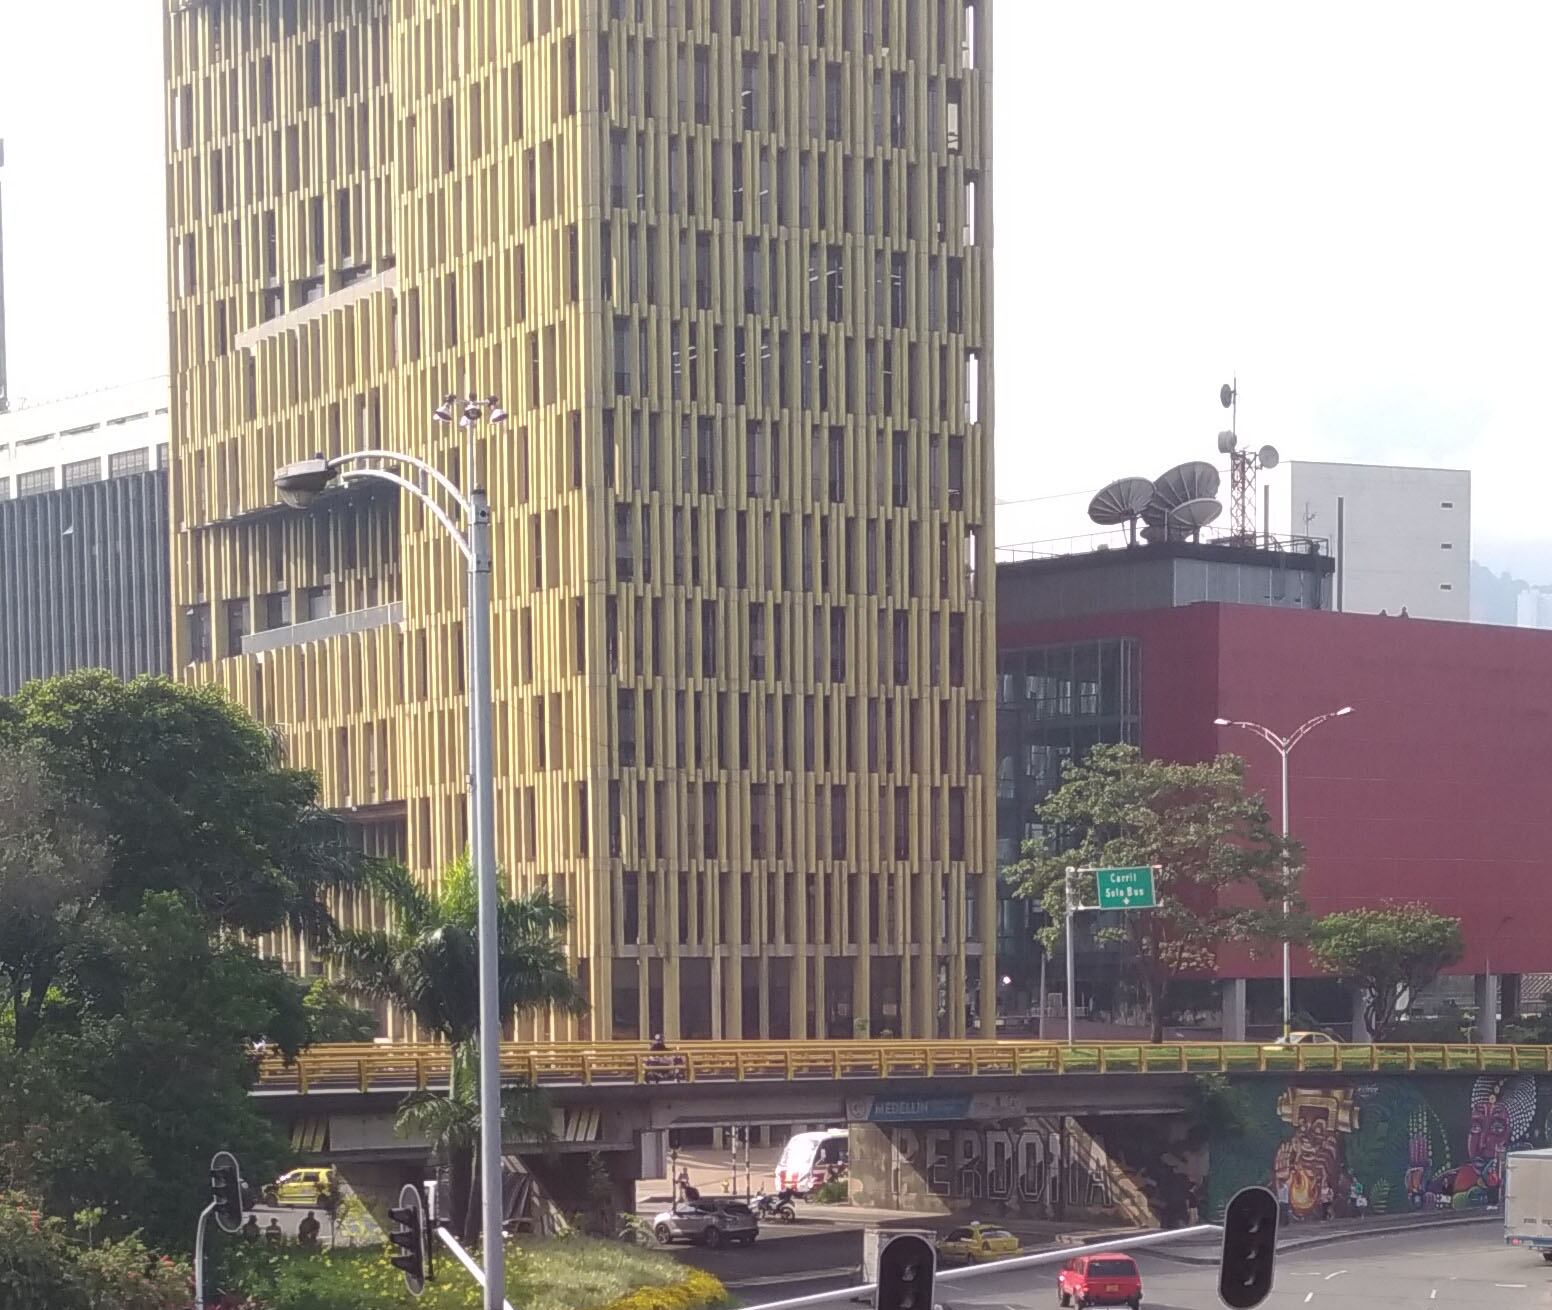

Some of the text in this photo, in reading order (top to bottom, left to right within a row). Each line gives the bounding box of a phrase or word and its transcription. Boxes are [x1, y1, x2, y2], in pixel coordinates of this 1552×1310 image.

[1110, 872, 1137, 883] Carril
[1105, 886, 1145, 898] Solo Bus
